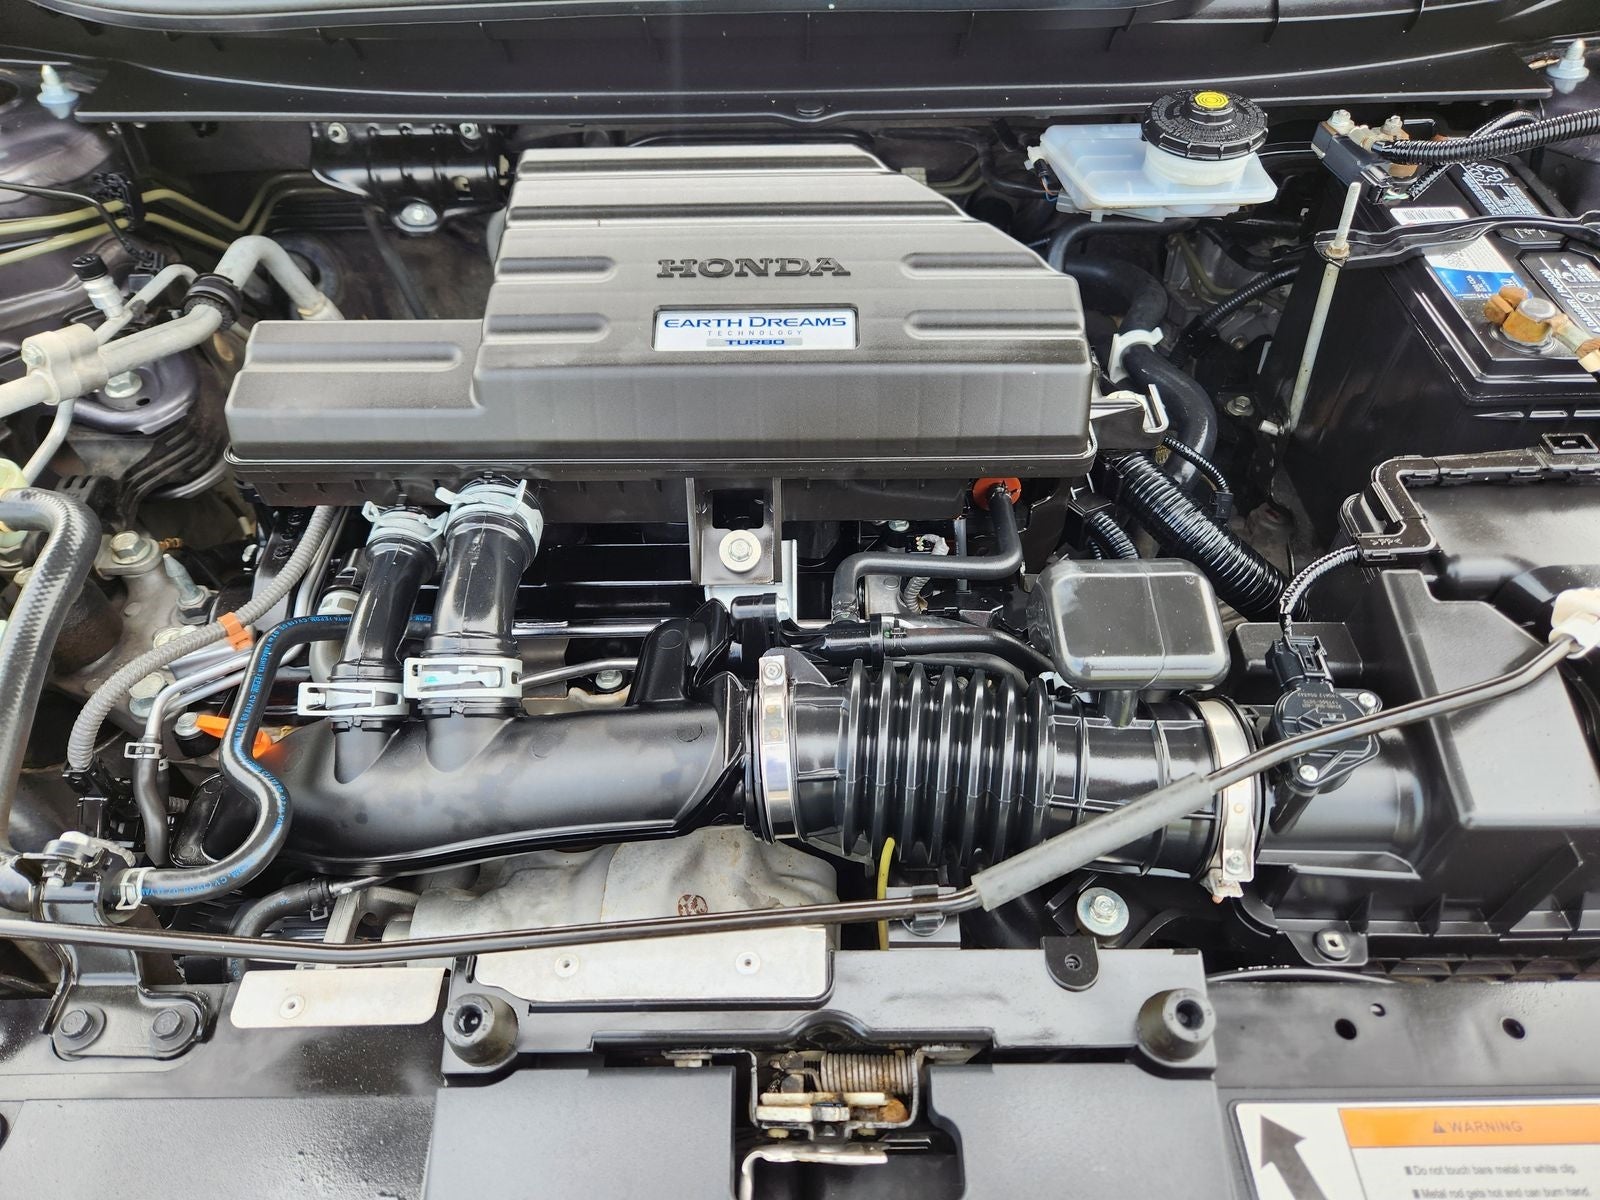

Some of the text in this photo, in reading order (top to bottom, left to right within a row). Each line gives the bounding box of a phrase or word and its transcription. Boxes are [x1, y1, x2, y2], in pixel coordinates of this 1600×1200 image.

[657, 258, 851, 278] HONDA
[1540, 269, 1567, 293] POISON
[1566, 298, 1598, 327] DANGER
[664, 316, 846, 328] EARTH DREAMS
[257, 643, 273, 674] YAMASHITA
[1448, 1120, 1523, 1133] WARNING
[1413, 1165, 1428, 1176] Do
[1429, 1165, 1443, 1175] not
[1446, 1165, 1470, 1175] touch
[1472, 1165, 1493, 1175] bare
[1495, 1164, 1520, 1175] metal
[1534, 1164, 1558, 1174] white
[1421, 1188, 1447, 1199] Metal
[1449, 1189, 1464, 1199] rod
[1468, 1189, 1486, 1200] gets
[1488, 1188, 1502, 1198] hot
[1505, 1188, 1523, 1198] and
[1525, 1189, 1540, 1198] can
[1543, 1187, 1564, 1198] burn
